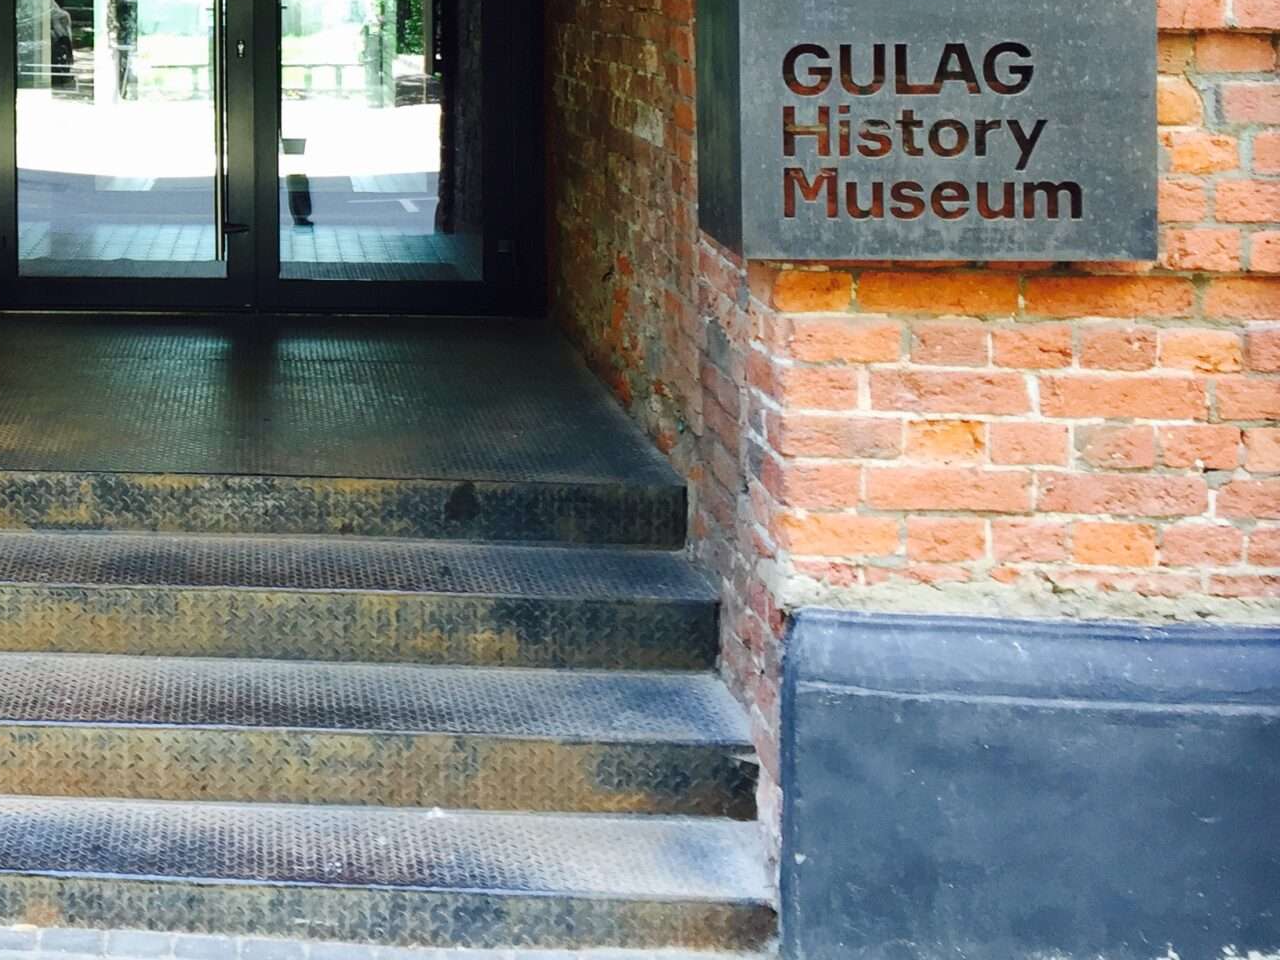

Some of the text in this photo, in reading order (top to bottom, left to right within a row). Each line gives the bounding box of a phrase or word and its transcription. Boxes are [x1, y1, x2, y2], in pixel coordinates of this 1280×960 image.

[781, 42, 1035, 96] GULAG
[782, 105, 1048, 170] History
[782, 167, 1083, 220] Museum
